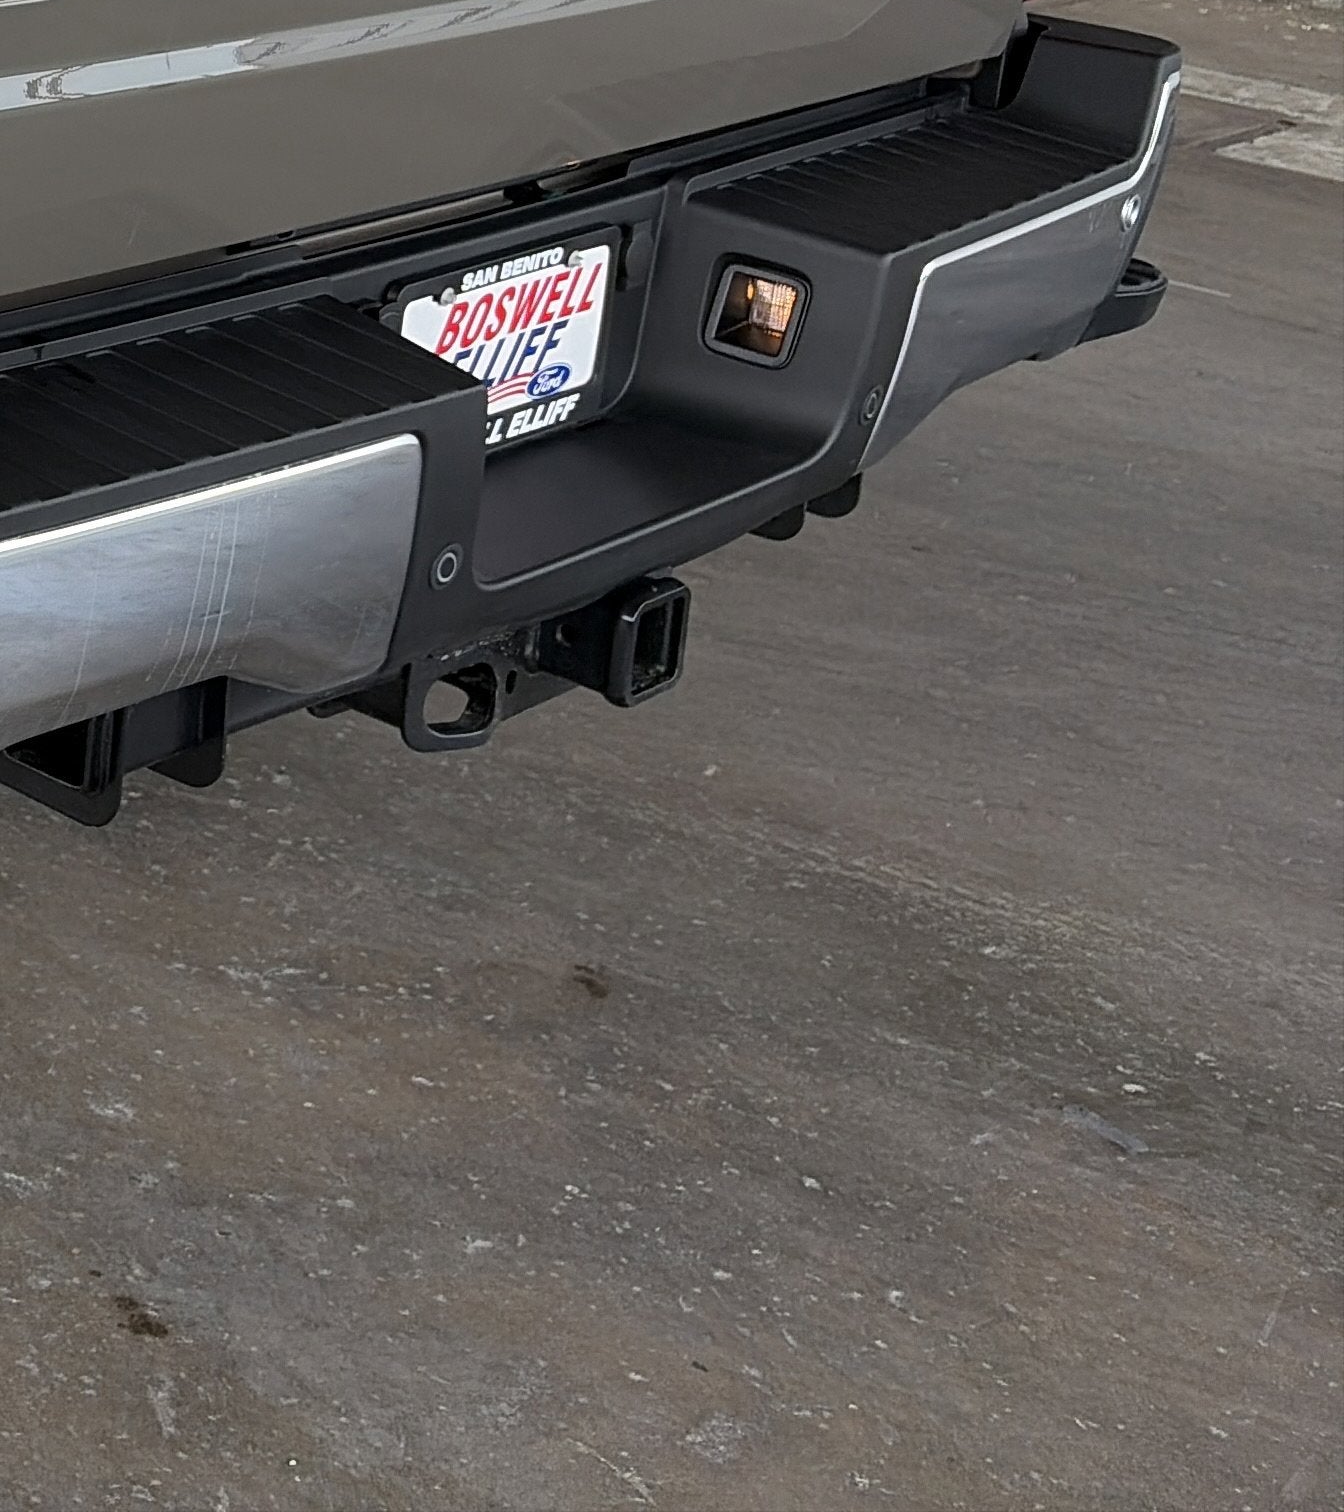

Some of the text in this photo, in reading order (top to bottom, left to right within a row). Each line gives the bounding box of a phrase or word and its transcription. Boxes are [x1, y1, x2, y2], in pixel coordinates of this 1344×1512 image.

[461, 247, 564, 292] SAN BENITO
[435, 262, 603, 357] BOSWELL
[505, 392, 580, 439] ELLIFF
